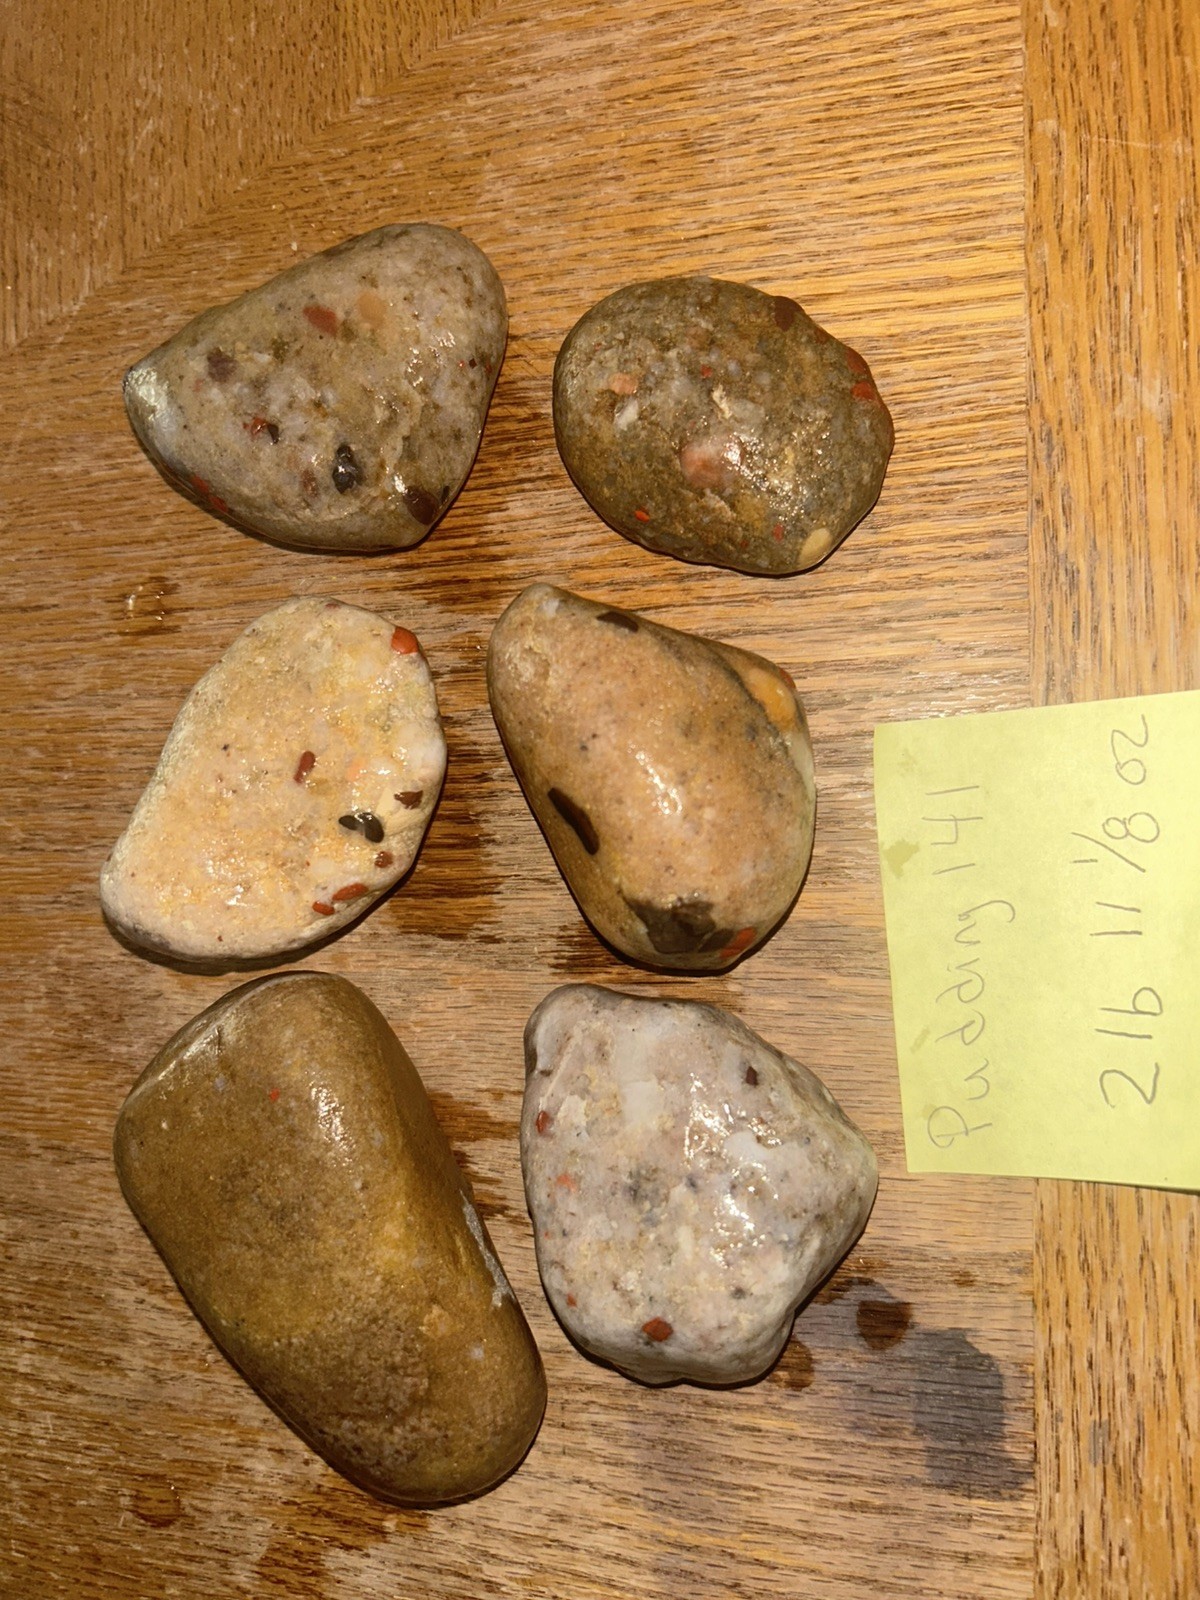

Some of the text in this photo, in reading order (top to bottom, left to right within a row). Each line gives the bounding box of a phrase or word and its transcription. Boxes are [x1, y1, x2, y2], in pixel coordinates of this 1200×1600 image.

[921, 785, 1016, 1149] Pudding 141
[1070, 713, 1164, 1109] 2 lb 11 1/8 oz
